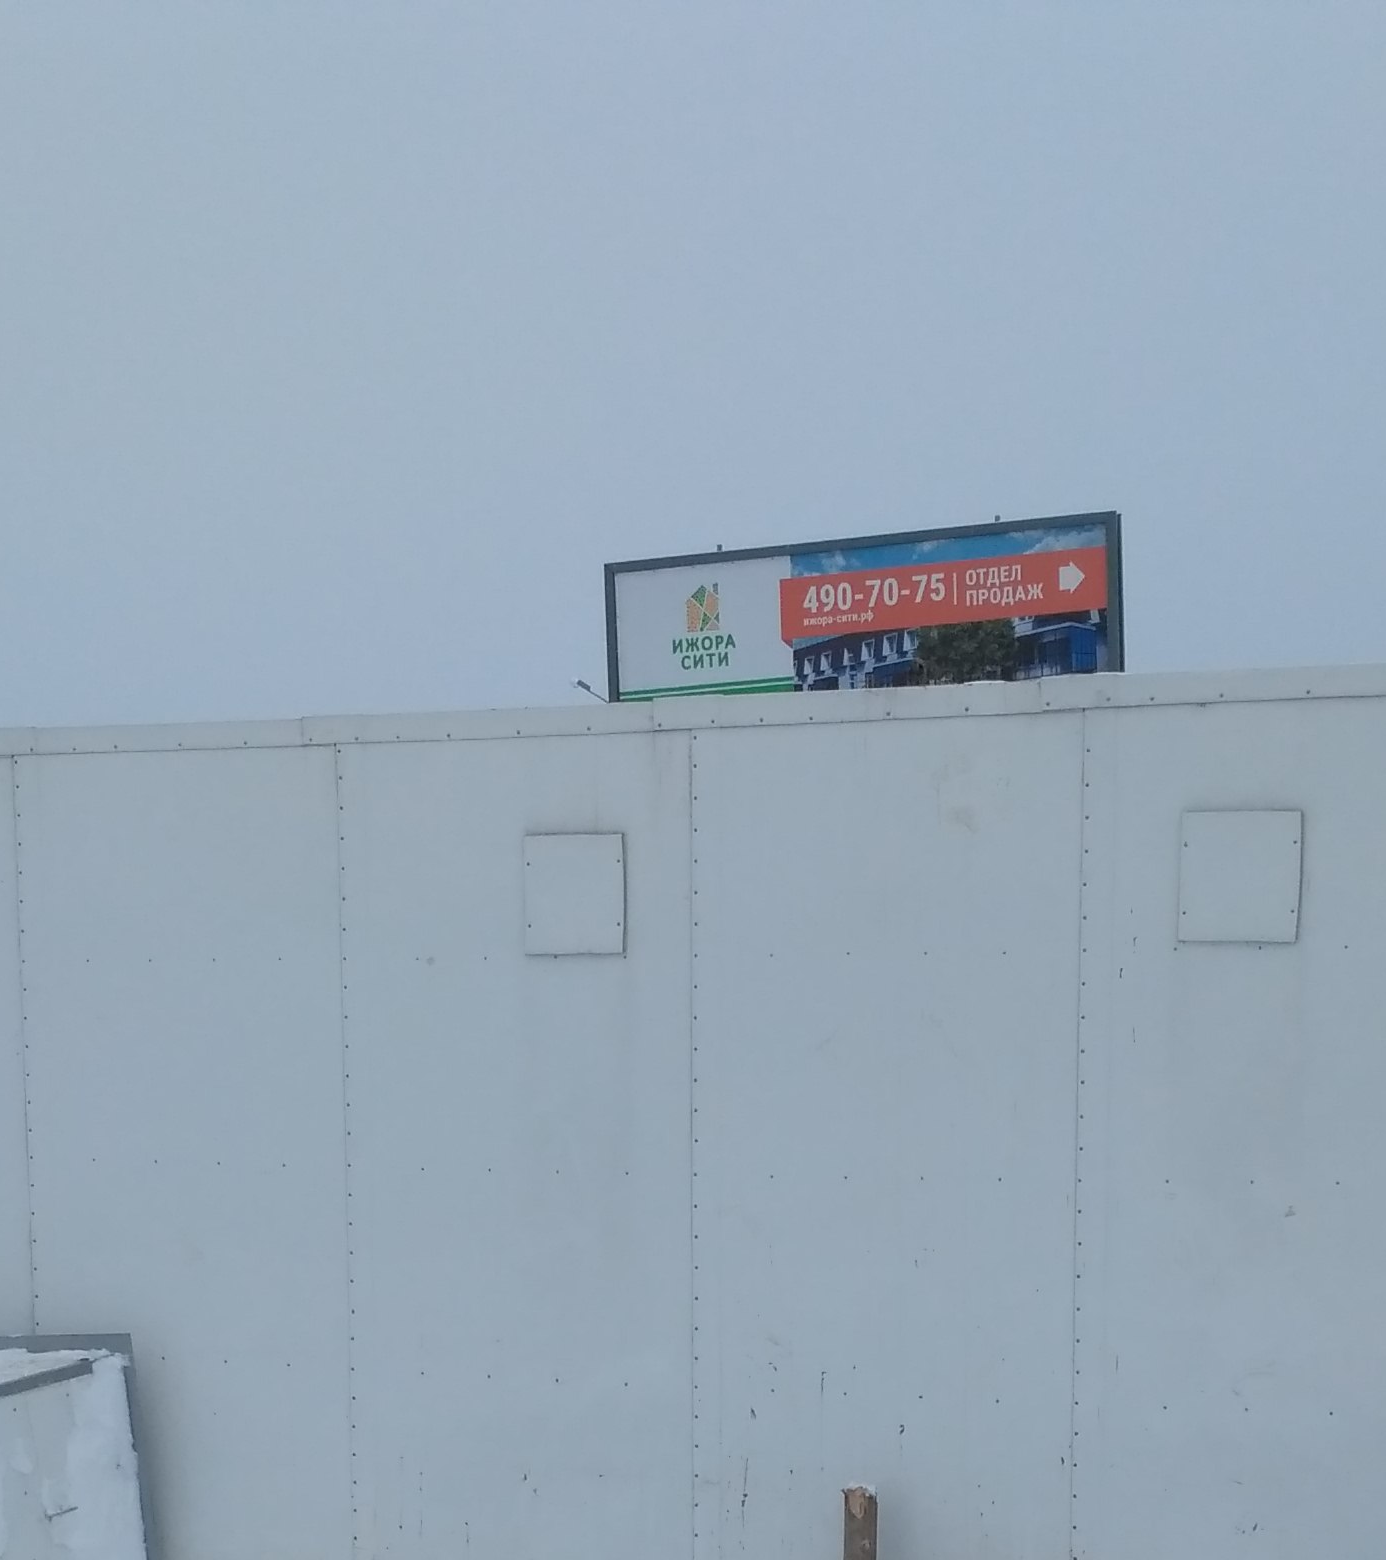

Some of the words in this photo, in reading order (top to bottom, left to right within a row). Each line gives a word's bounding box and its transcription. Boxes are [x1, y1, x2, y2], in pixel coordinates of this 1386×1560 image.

[965, 564, 1022, 587] ОТДЕЛ
[803, 572, 946, 613] 490-70-75
[966, 582, 1044, 607] ПРОДАЖ
[803, 609, 874, 627] ижора-сити.рф
[672, 633, 736, 654] ИЖОРА
[681, 651, 729, 670] СИТИ
